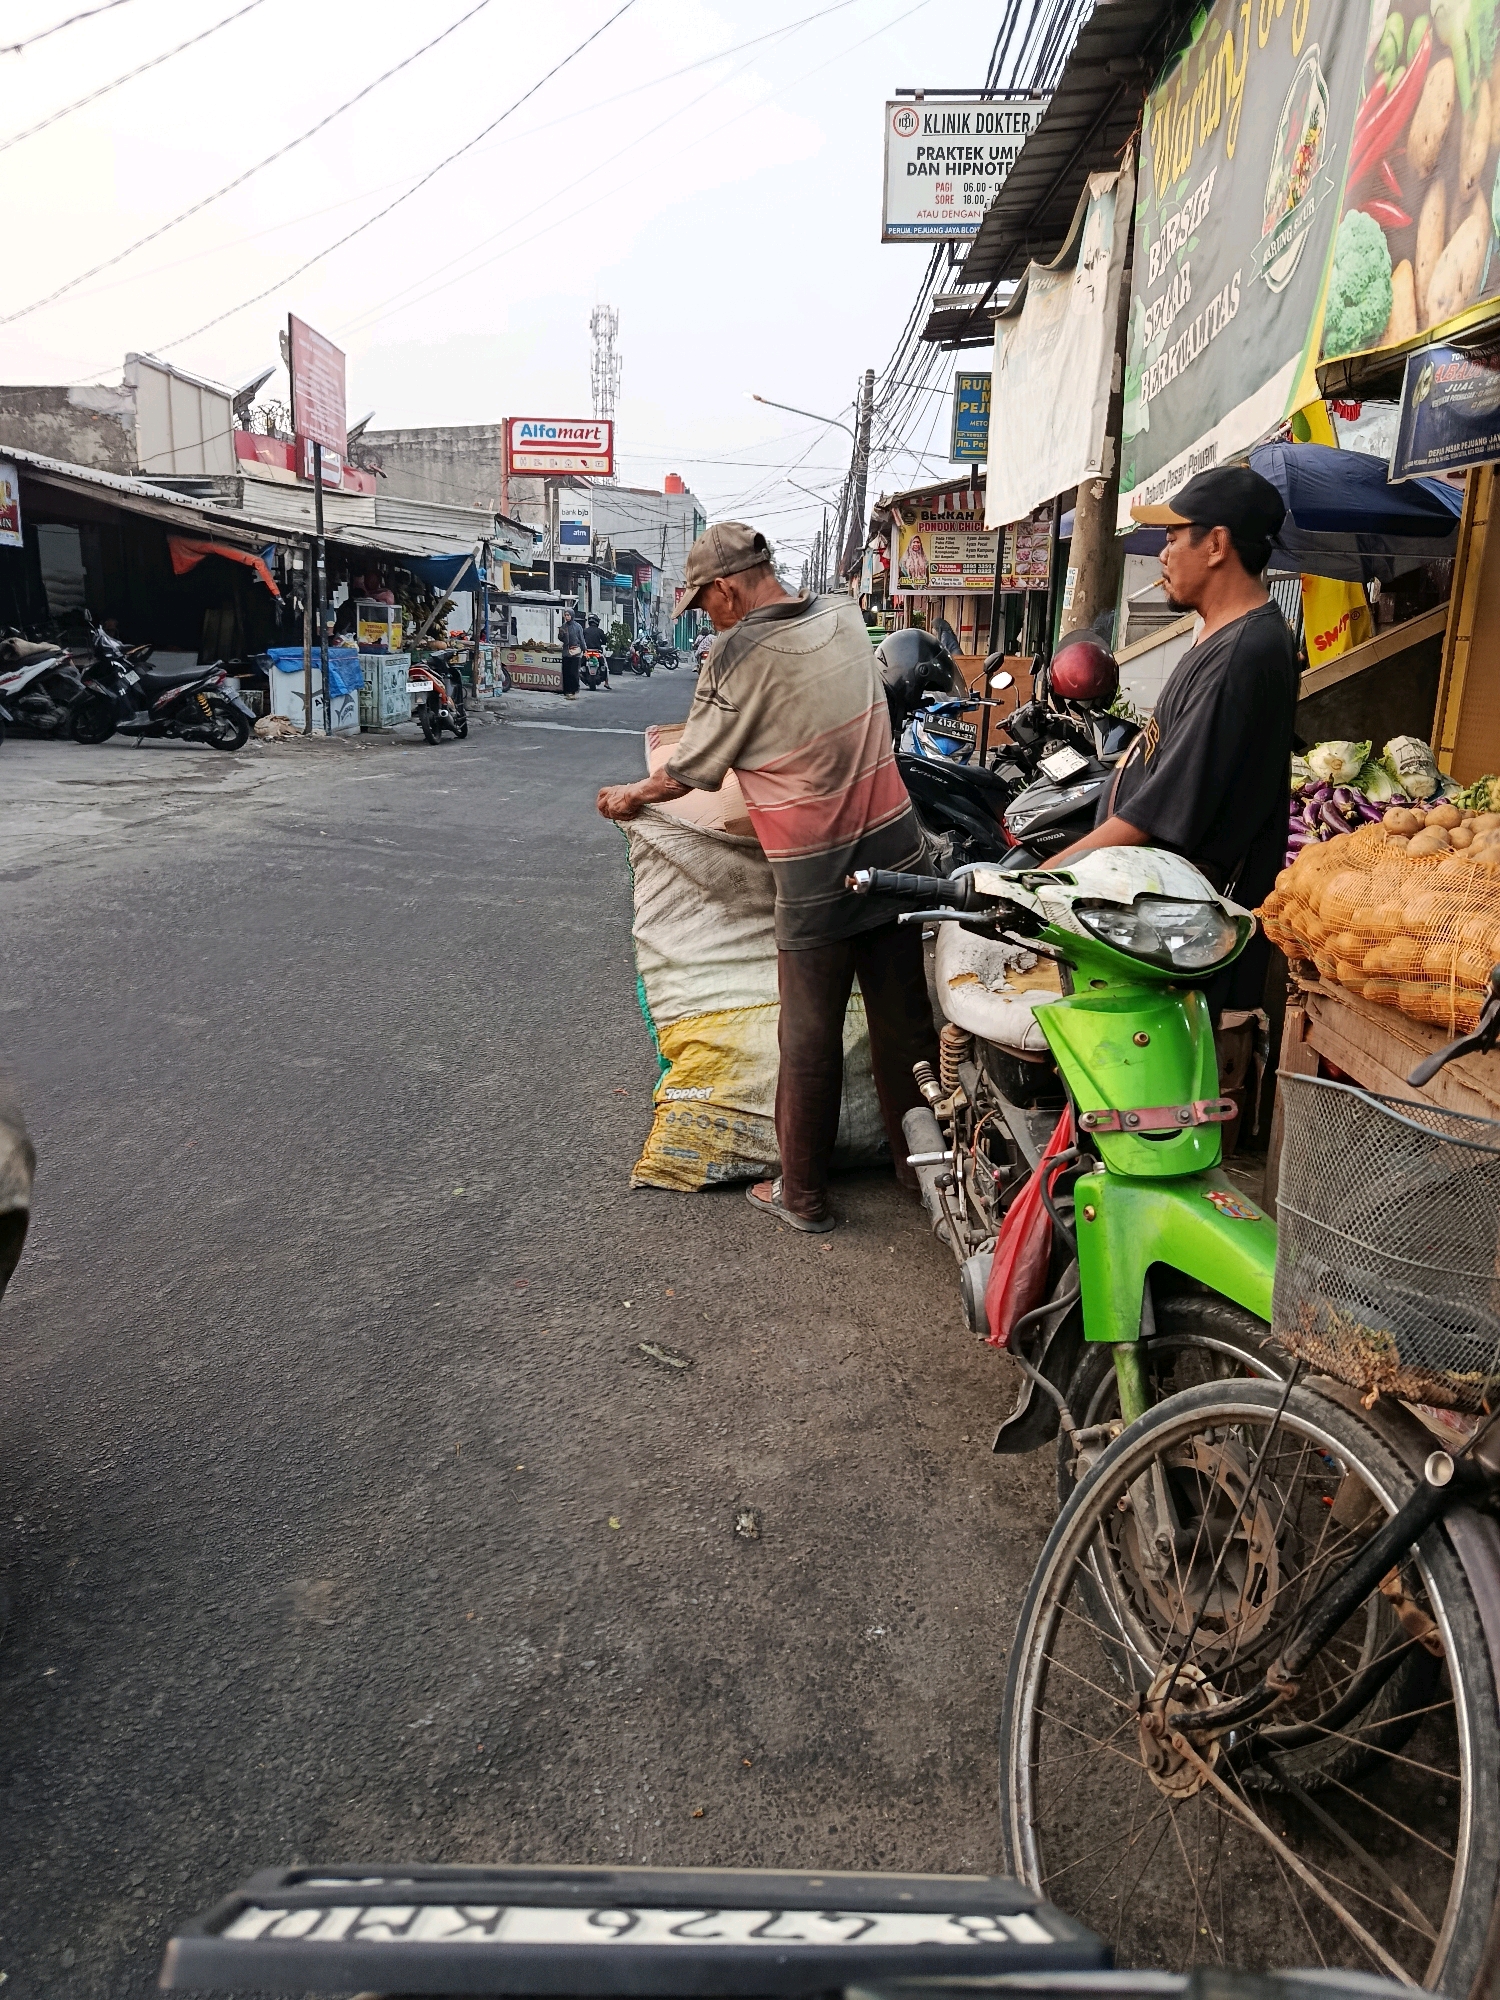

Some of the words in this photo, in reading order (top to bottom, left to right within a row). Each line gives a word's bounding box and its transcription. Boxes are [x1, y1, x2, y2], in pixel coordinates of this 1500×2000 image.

[923, 113, 971, 133] KLINIK
[976, 112, 1030, 133] DOKTER
[917, 147, 984, 160] PRAKTEK
[907, 162, 940, 176] DAN
[935, 182, 953, 192] PAGI
[963, 182, 987, 193] 06.00
[935, 195, 954, 205] SORE
[963, 195, 985, 205] 18.00
[917, 210, 939, 218] ATAU
[941, 209, 981, 218] DENGAN
[1142, 260, 1192, 350] SEGAR
[1139, 268, 1243, 410] BERKUALITAS
[1445, 381, 1475, 393] JUAL
[520, 423, 602, 440] Alfamart
[1461, 438, 1488, 450] PEJUANG
[561, 508, 577, 516] bank
[918, 521, 956, 532] PONDOK
[573, 529, 587, 537] atm
[1036, 832, 1066, 843] HONDA
